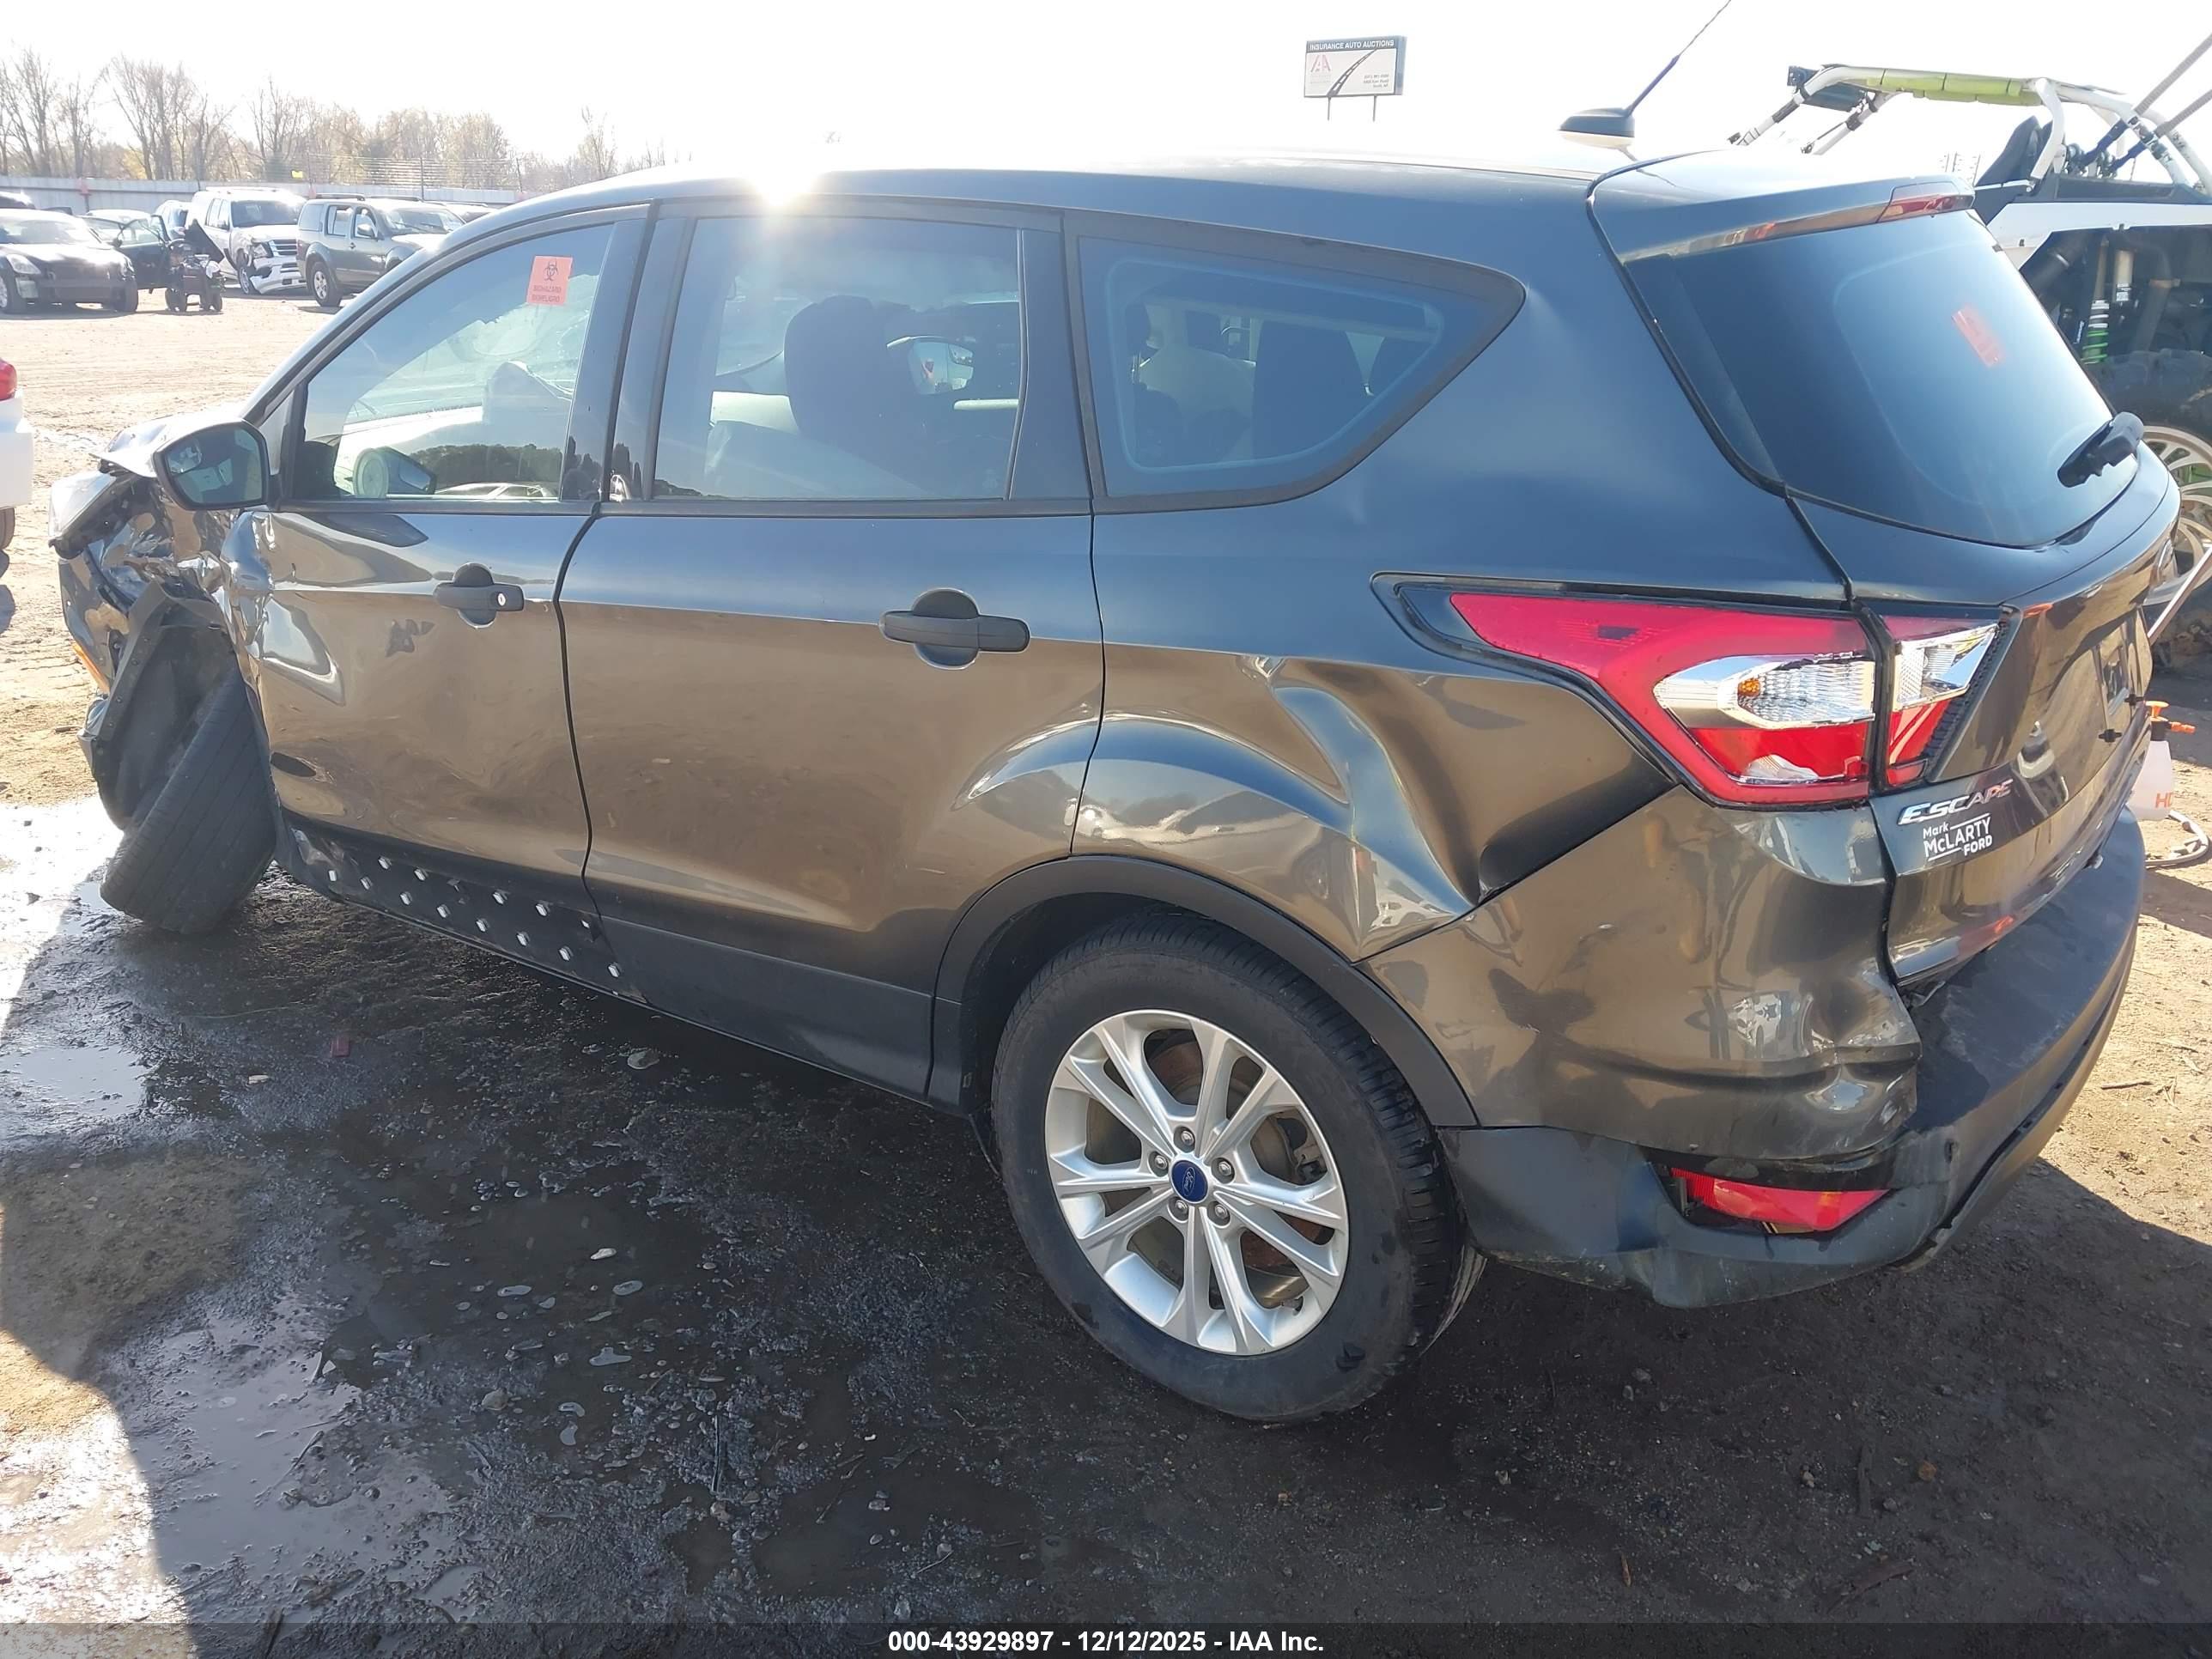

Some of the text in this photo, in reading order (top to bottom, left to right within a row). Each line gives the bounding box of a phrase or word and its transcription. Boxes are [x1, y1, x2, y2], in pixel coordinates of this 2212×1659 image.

[1310, 42, 1344, 51] INSURANCE
[1363, 40, 1395, 48] AUCTIONS
[1897, 778, 2014, 825] ESCAPE
[1923, 822, 1949, 839] Mark
[1923, 817, 1991, 857] McLARTY
[1963, 835, 1993, 856] FORD
